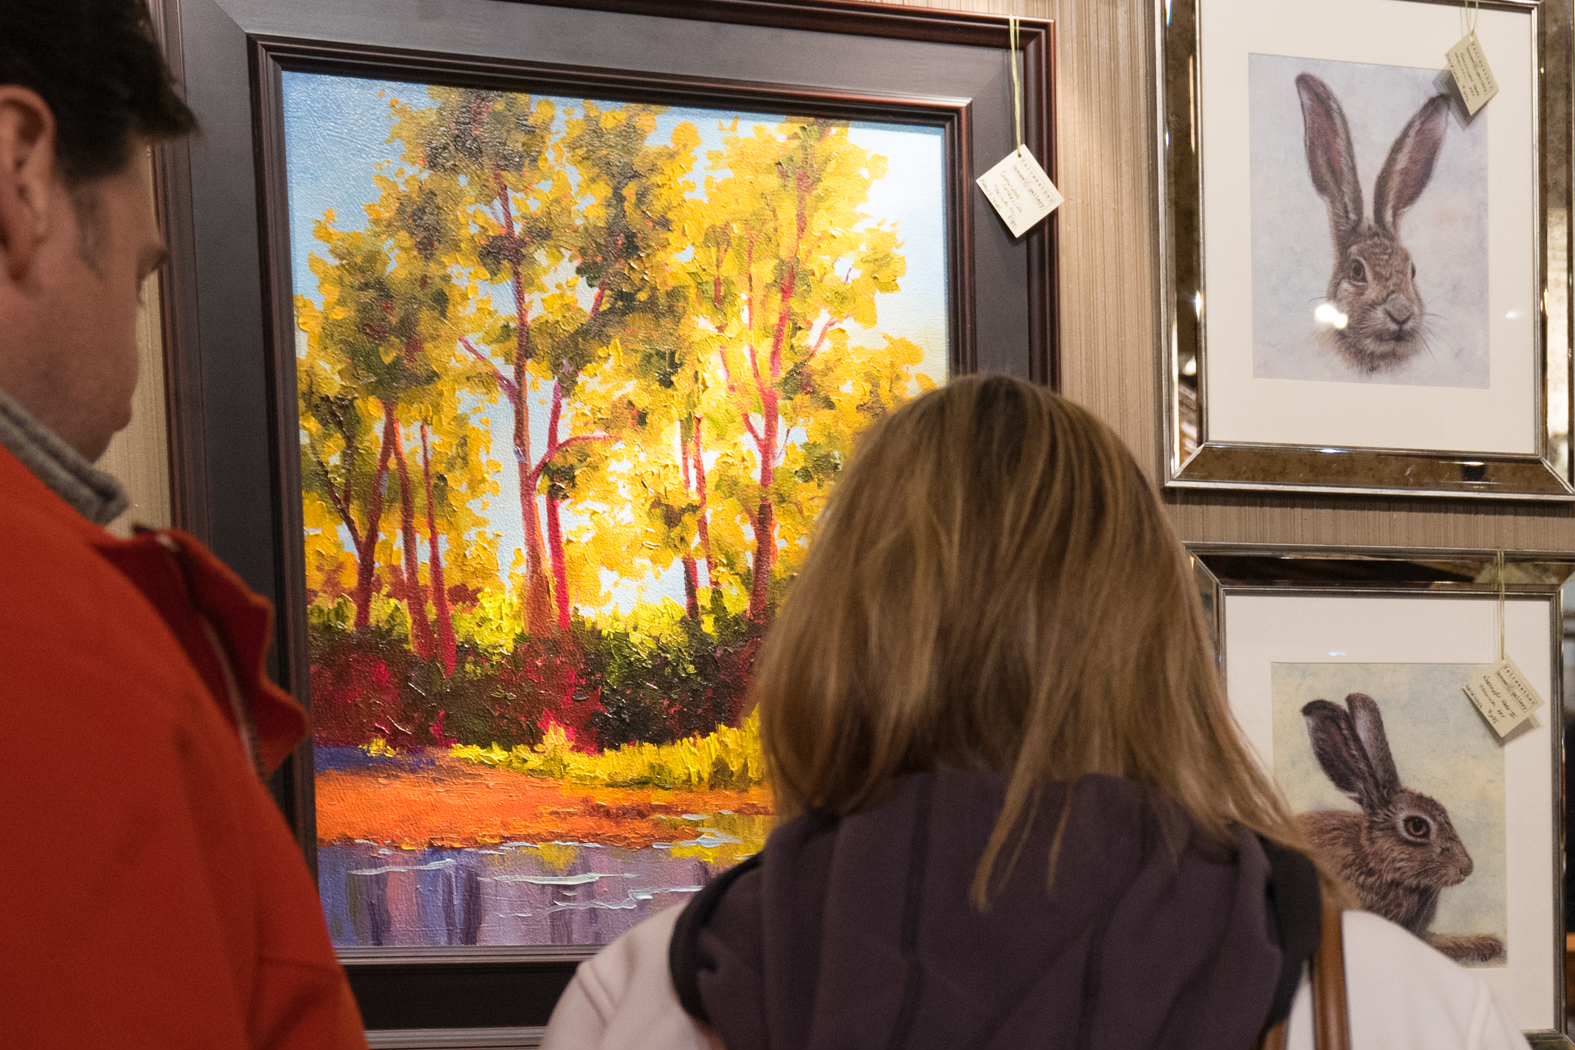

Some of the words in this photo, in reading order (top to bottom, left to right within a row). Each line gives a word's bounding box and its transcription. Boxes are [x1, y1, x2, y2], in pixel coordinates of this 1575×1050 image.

[1020, 158, 1054, 203] fairweather
[1027, 186, 1045, 209] gallery
[1503, 665, 1536, 705] fairweather
[1510, 690, 1528, 711] gallery
